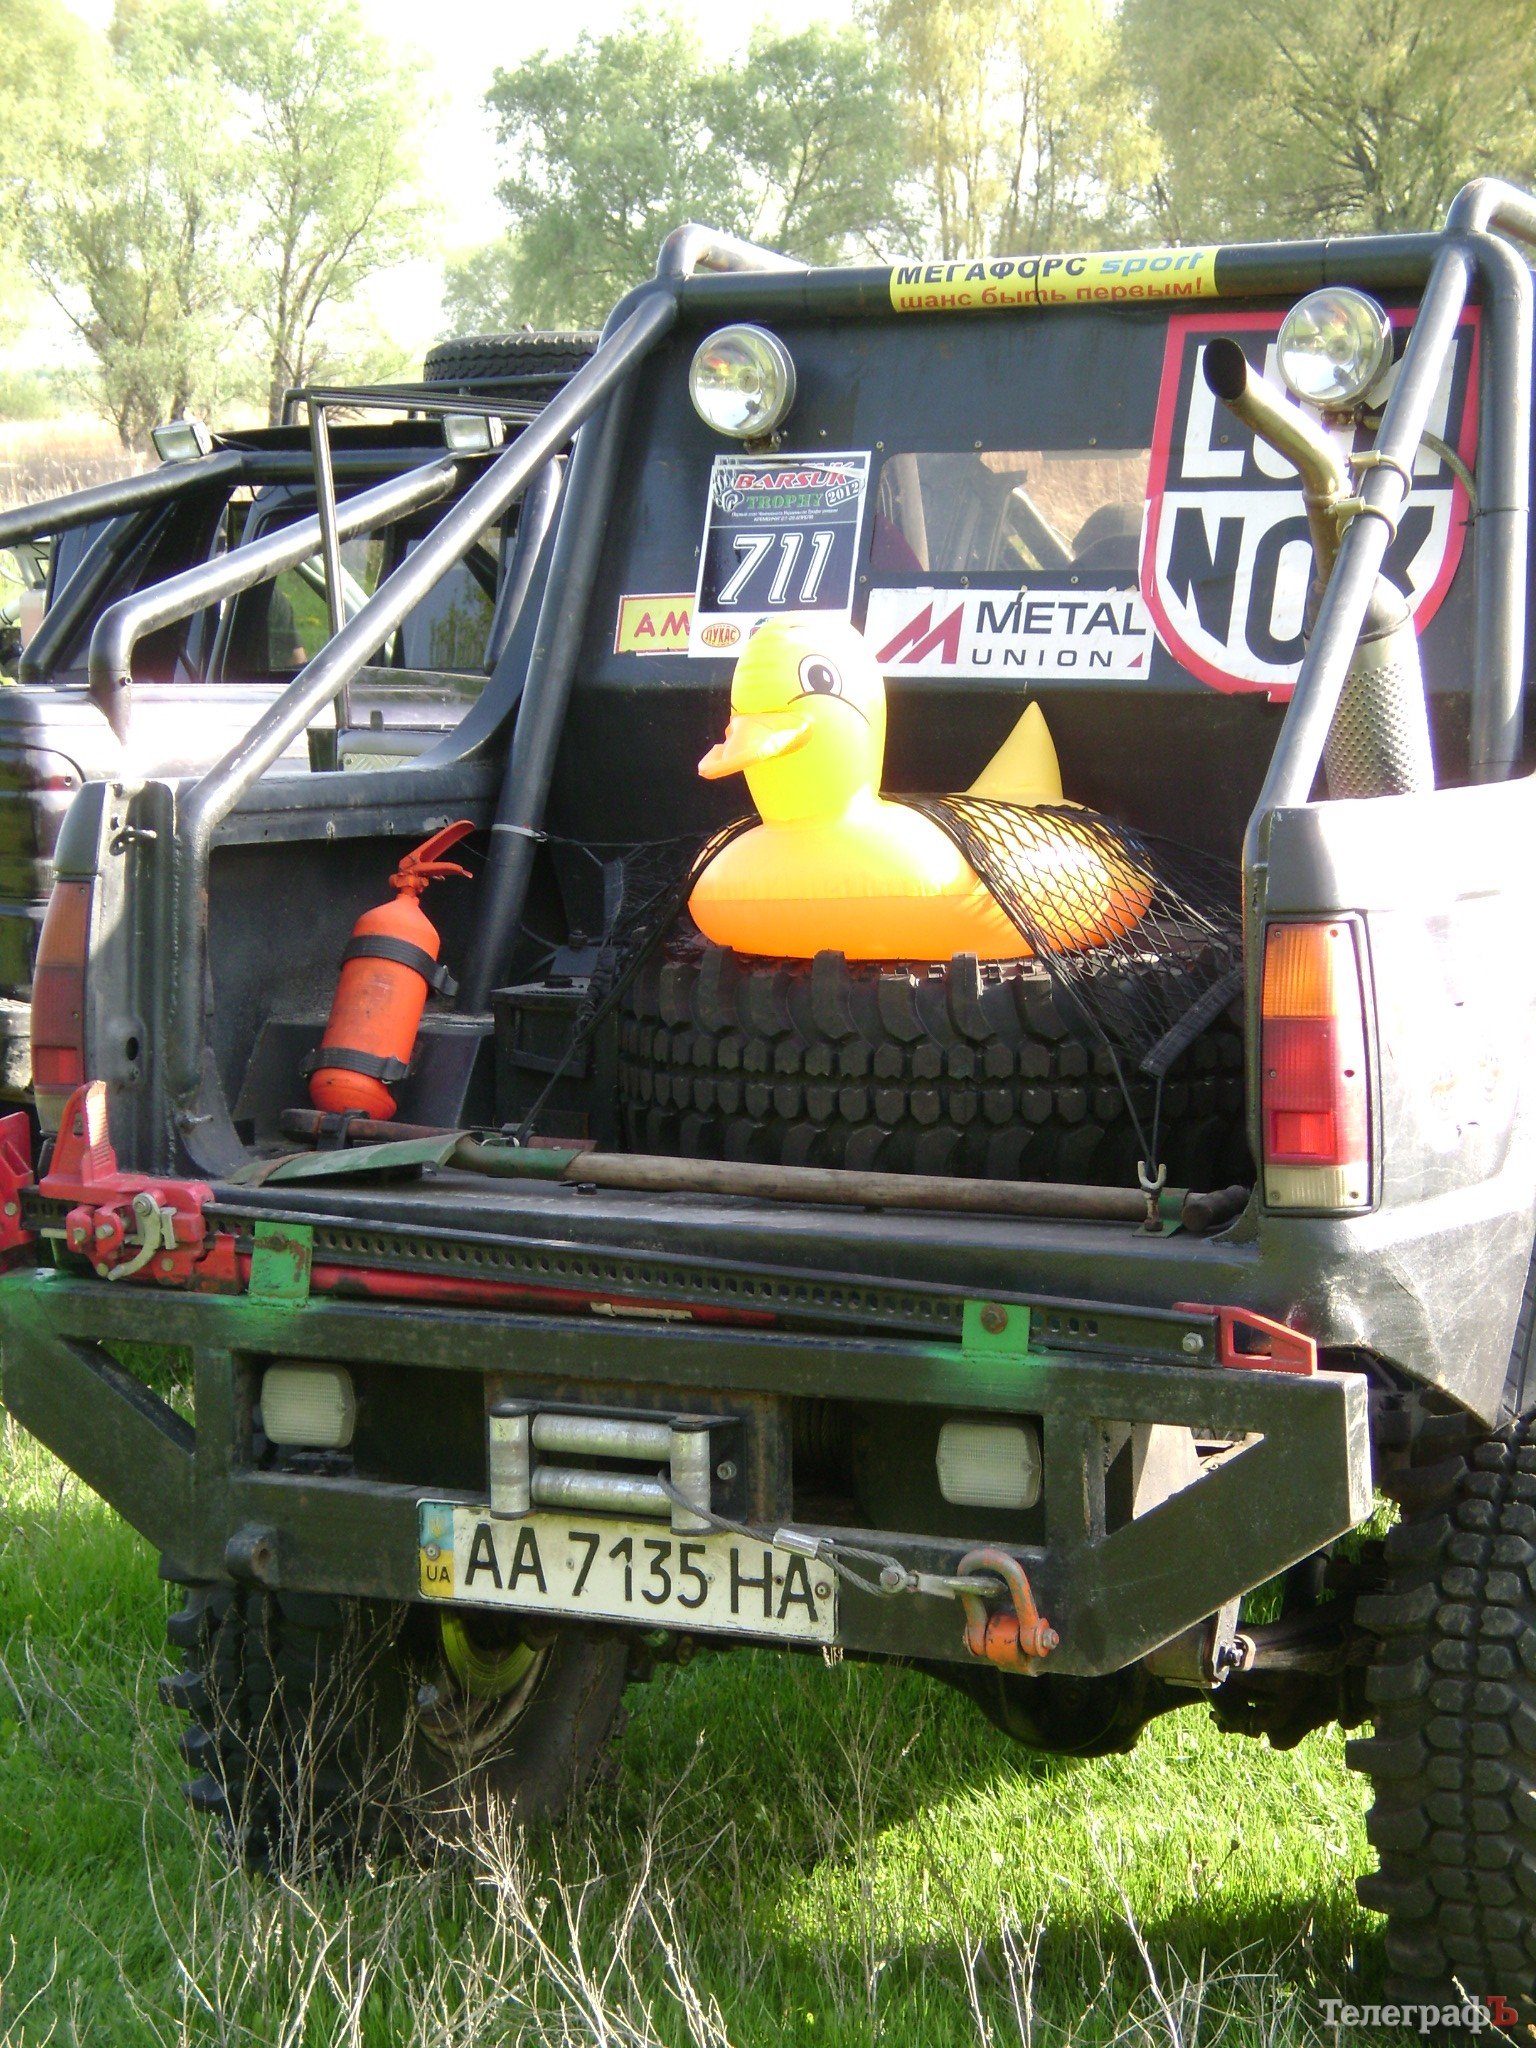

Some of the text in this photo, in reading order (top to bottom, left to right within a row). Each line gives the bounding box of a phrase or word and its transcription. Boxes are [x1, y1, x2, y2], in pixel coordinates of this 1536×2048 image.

[896, 256, 1087, 285] МЕГАФОРС
[1100, 251, 1204, 277] sport
[900, 277, 1202, 310] шанс быть первым!
[735, 468, 849, 491] BARSUK
[827, 481, 860, 504] 2012
[745, 492, 824, 510] TROPHY
[717, 531, 835, 605] 711
[976, 600, 1147, 636] METAL
[971, 648, 1113, 668] UNION
[426, 1565, 451, 1584] UA
[464, 1522, 820, 1623] AA 7135 HA
